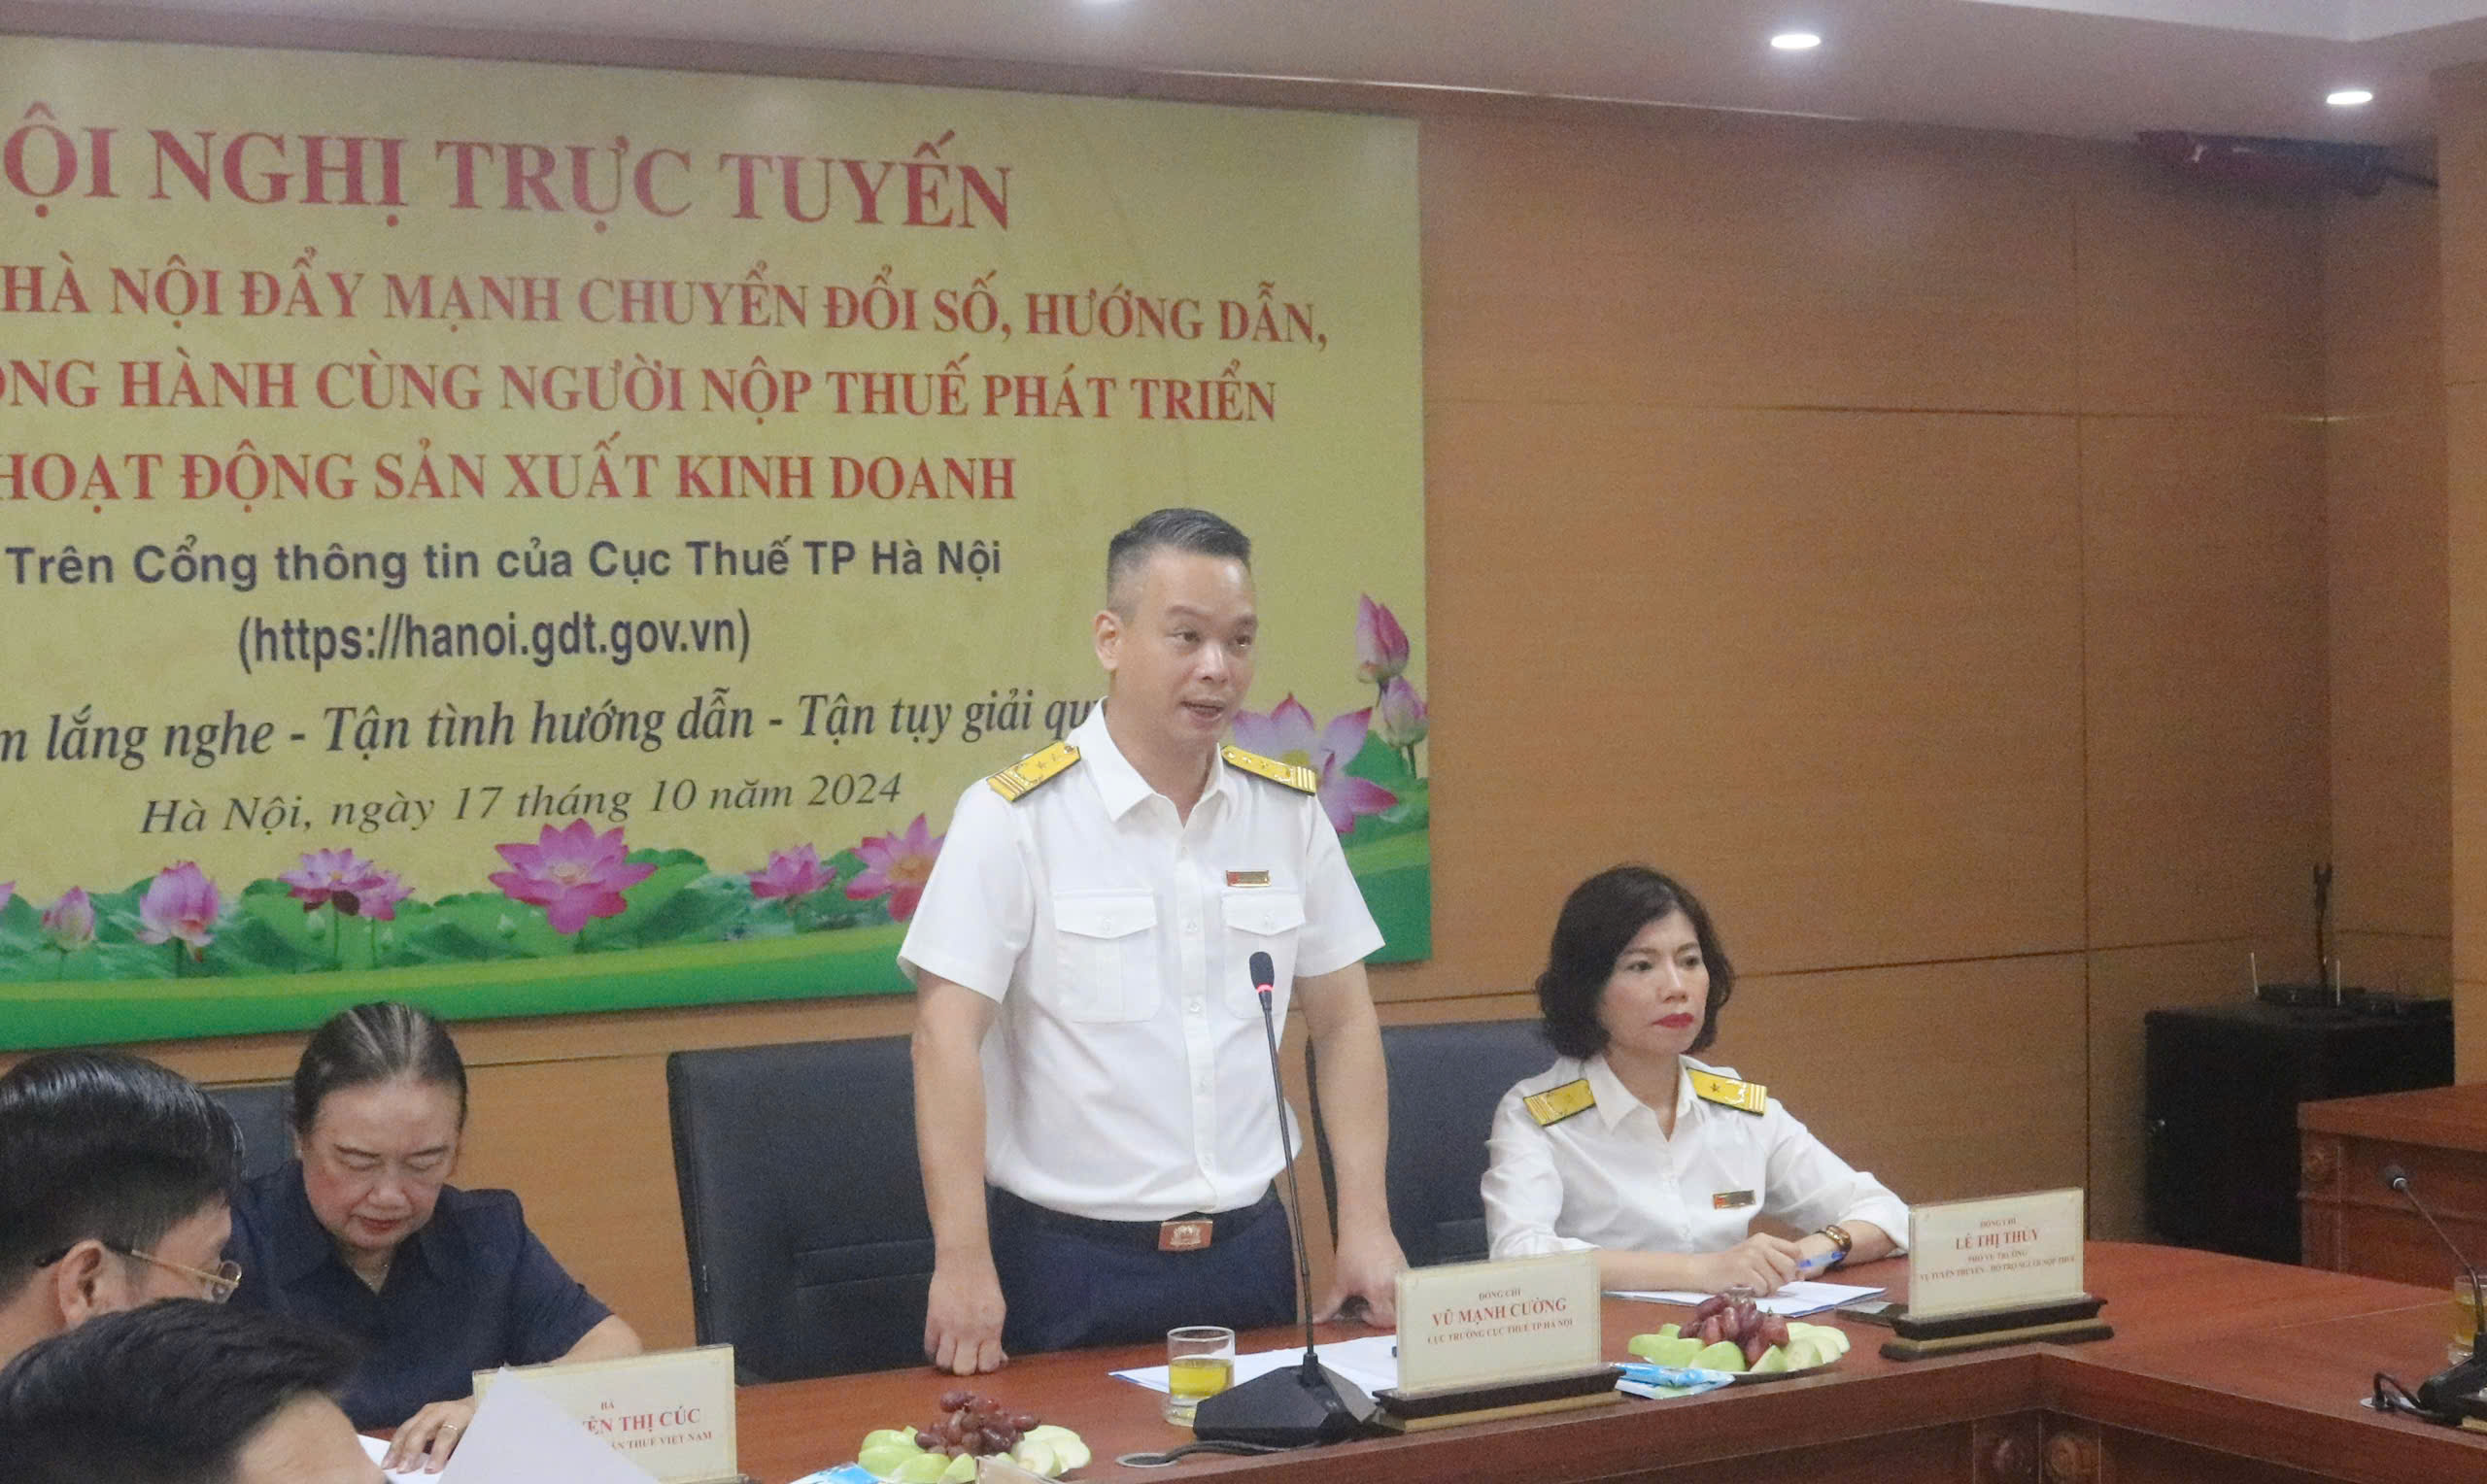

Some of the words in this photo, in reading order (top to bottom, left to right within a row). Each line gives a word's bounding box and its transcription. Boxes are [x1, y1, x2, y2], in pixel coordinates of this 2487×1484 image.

[148, 128, 411, 227] NGHỊ
[434, 131, 692, 233] TRỰC
[718, 129, 1012, 230] TUYẾN
[0, 251, 90, 314] HÀ
[109, 253, 222, 328] NỘI
[240, 246, 364, 319] ĐẨY
[383, 273, 560, 333] MẠNH
[578, 260, 807, 327] CHUYỂN
[824, 264, 918, 331] ĐỔI
[934, 270, 1012, 342] SỐ,
[1026, 282, 1204, 340] HƯỚNG
[1218, 280, 1327, 350] DẪN,
[0, 359, 100, 408] NG
[119, 346, 298, 409] HÀNH
[316, 349, 482, 410] CÙNG
[500, 352, 685, 412] NGƯỜI
[700, 354, 812, 425] NỘP
[825, 352, 971, 417] THUẾ
[983, 362, 1117, 419] PHÁT
[1130, 358, 1276, 422] TRIỂN
[180, 437, 358, 514] ĐỘNG
[374, 437, 486, 499] SẢN
[504, 429, 659, 499] XUẤT
[676, 455, 815, 499] KINH
[830, 455, 1016, 500] DOANH
[4, 544, 114, 585] Trên
[133, 533, 257, 592] Cổng
[274, 542, 408, 590] thông
[423, 542, 479, 580] tin
[496, 536, 573, 579] của
[589, 540, 671, 585] Cục
[685, 534, 792, 577] Thuế
[802, 540, 857, 575] TP
[871, 539, 923, 575] Hà
[937, 539, 1002, 582] Nội
[237, 608, 750, 674] (https://hanoi.gdt.gov.vn)
[46, 703, 149, 771] lắng
[163, 708, 275, 769] nghe
[324, 704, 410, 761] Tận
[426, 700, 515, 748] tình
[530, 698, 666, 754] hướng
[676, 687, 754, 740] dẫn
[799, 692, 875, 746] Tận
[890, 697, 952, 745] tụy
[961, 688, 1034, 743] giải
[1041, 696, 1098, 743] qu
[140, 798, 207, 834] Hà
[222, 795, 311, 835] Nội,
[331, 791, 435, 834] ngày
[452, 786, 504, 820] 17
[517, 783, 632, 826] tháng
[651, 779, 697, 812] 10
[708, 779, 792, 810] năm
[807, 772, 902, 806] 2024
[1432, 1308, 1454, 1327] VŨ
[1458, 1304, 1507, 1326] MẠNH
[1510, 1297, 1567, 1318] CƯỜNG
[619, 1413, 654, 1433] THỊ
[659, 1404, 700, 1428] CÚC
